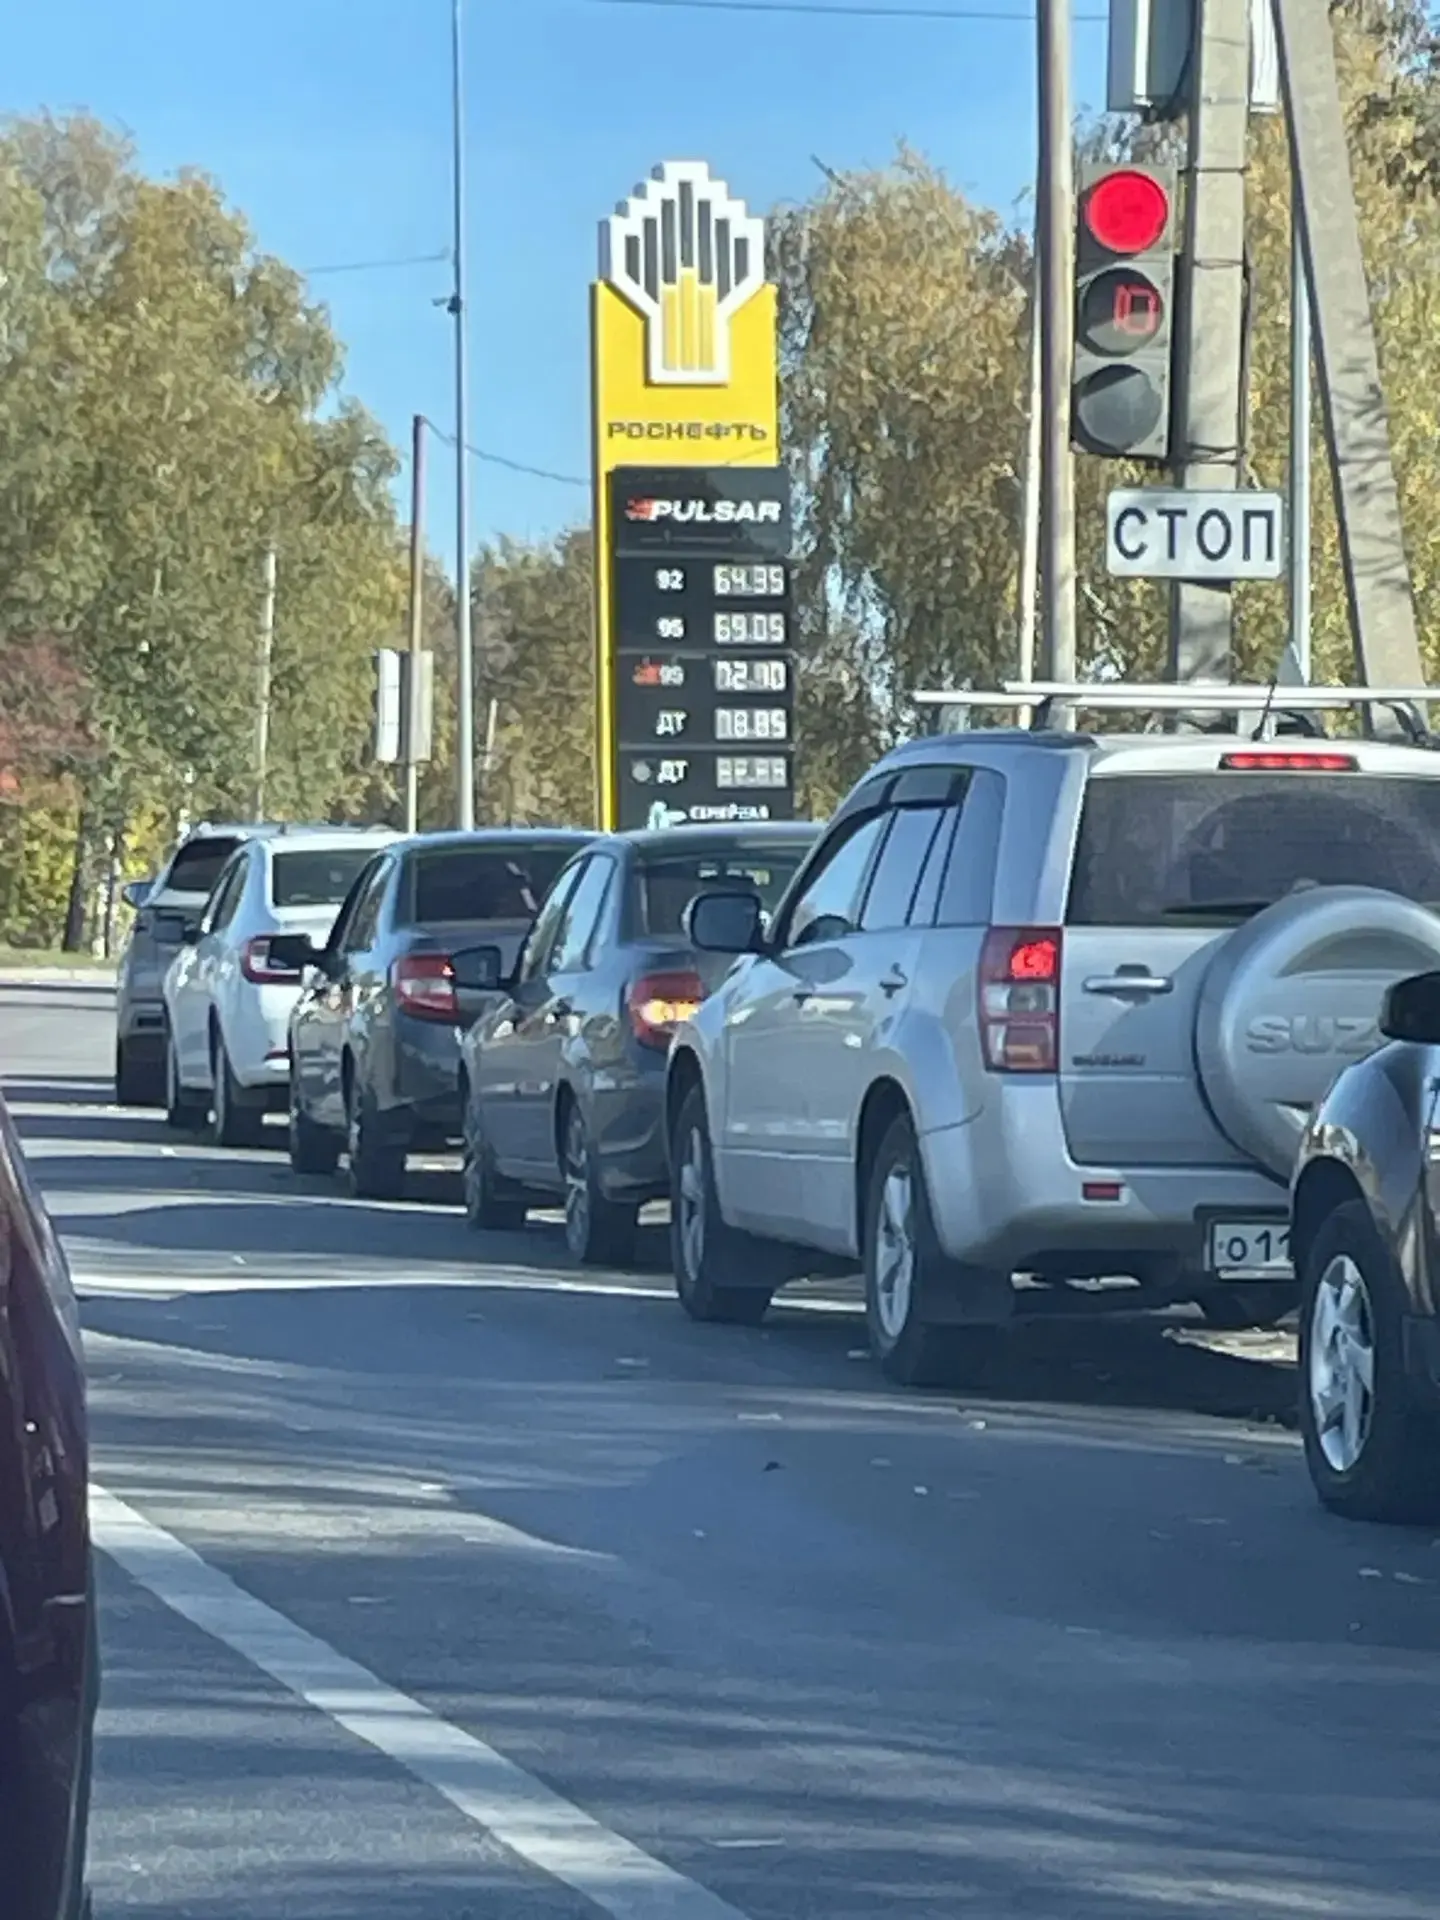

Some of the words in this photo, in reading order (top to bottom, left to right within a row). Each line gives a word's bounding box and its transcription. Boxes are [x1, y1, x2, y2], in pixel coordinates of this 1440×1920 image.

[607, 421, 768, 441] РОСНЕФТЬ
[650, 499, 782, 522] PULSAR
[1113, 506, 1276, 562] СТОП
[655, 568, 685, 590] 92
[656, 711, 687, 735] ДТ
[657, 760, 688, 783] ДТ
